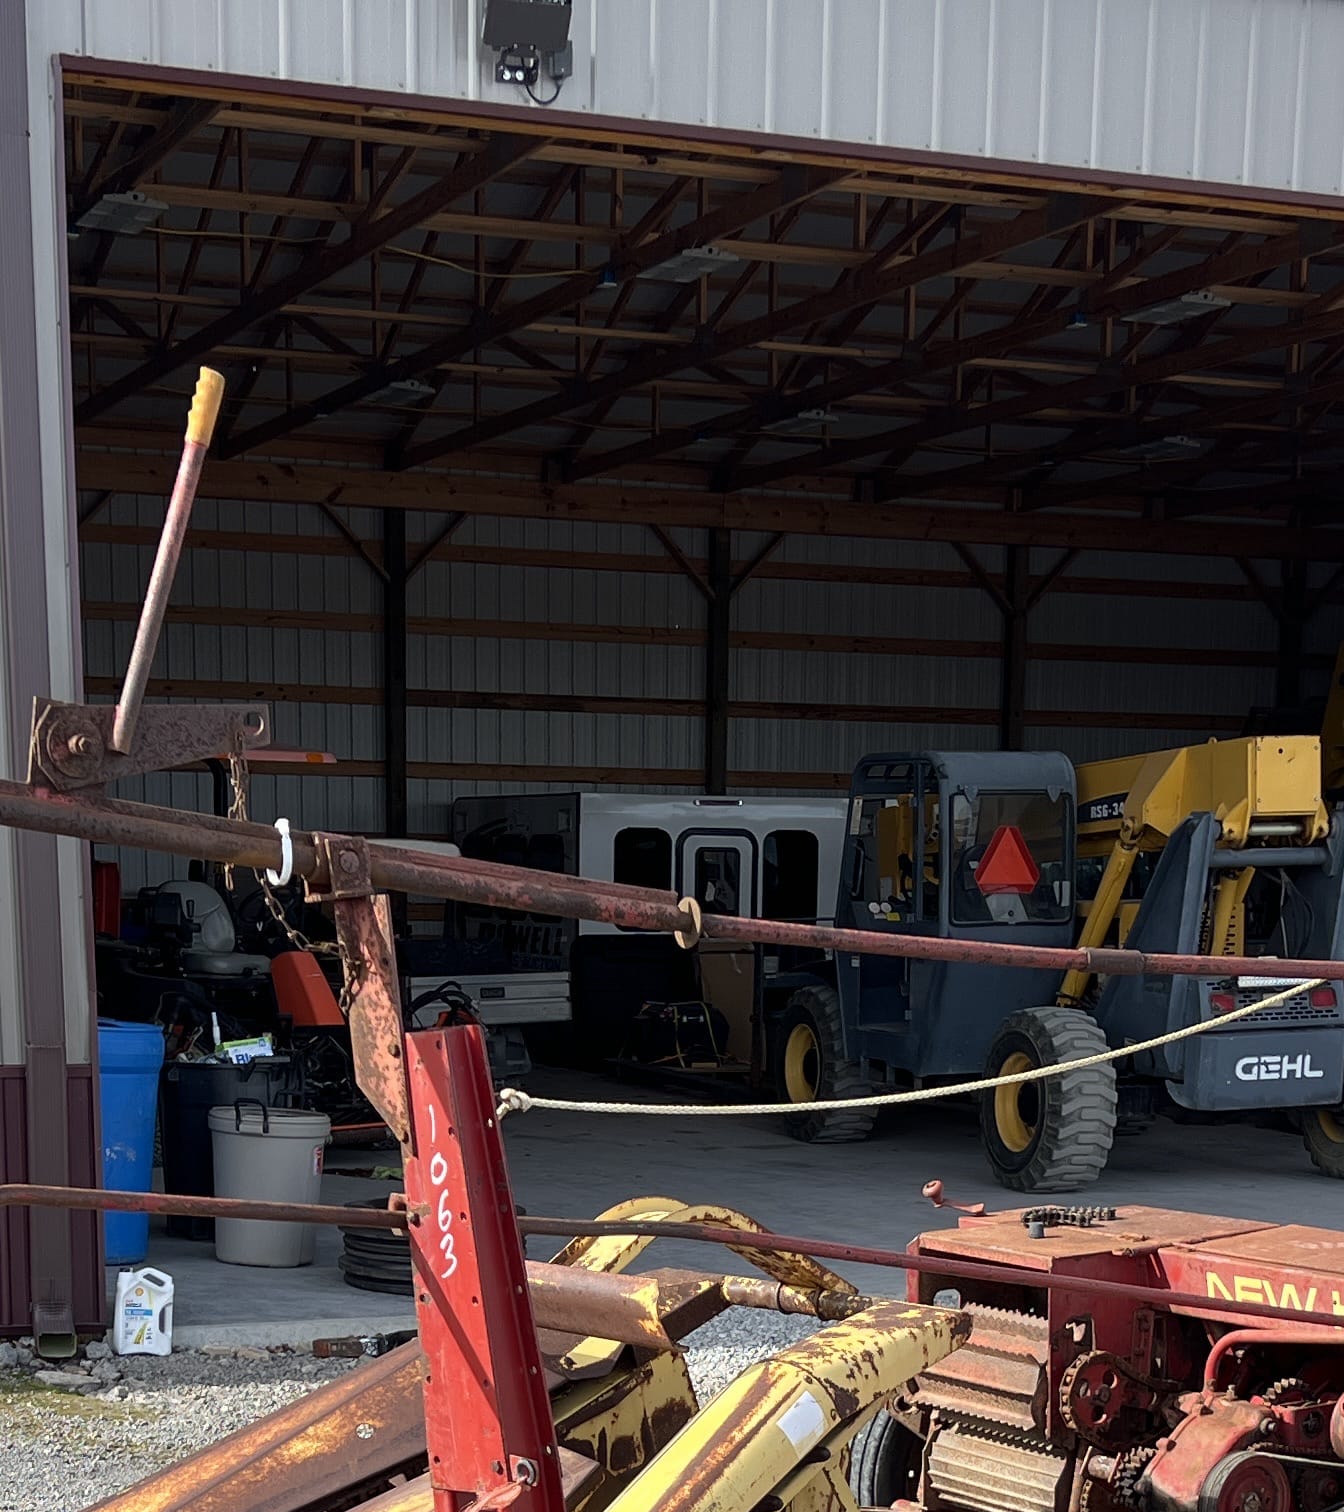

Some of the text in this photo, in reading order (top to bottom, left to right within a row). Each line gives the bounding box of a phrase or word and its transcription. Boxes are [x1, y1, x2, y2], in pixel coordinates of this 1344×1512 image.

[1235, 1055, 1324, 1081] GEHL
[428, 1103, 458, 1279] 1063
[1206, 1271, 1317, 1312] NEW
